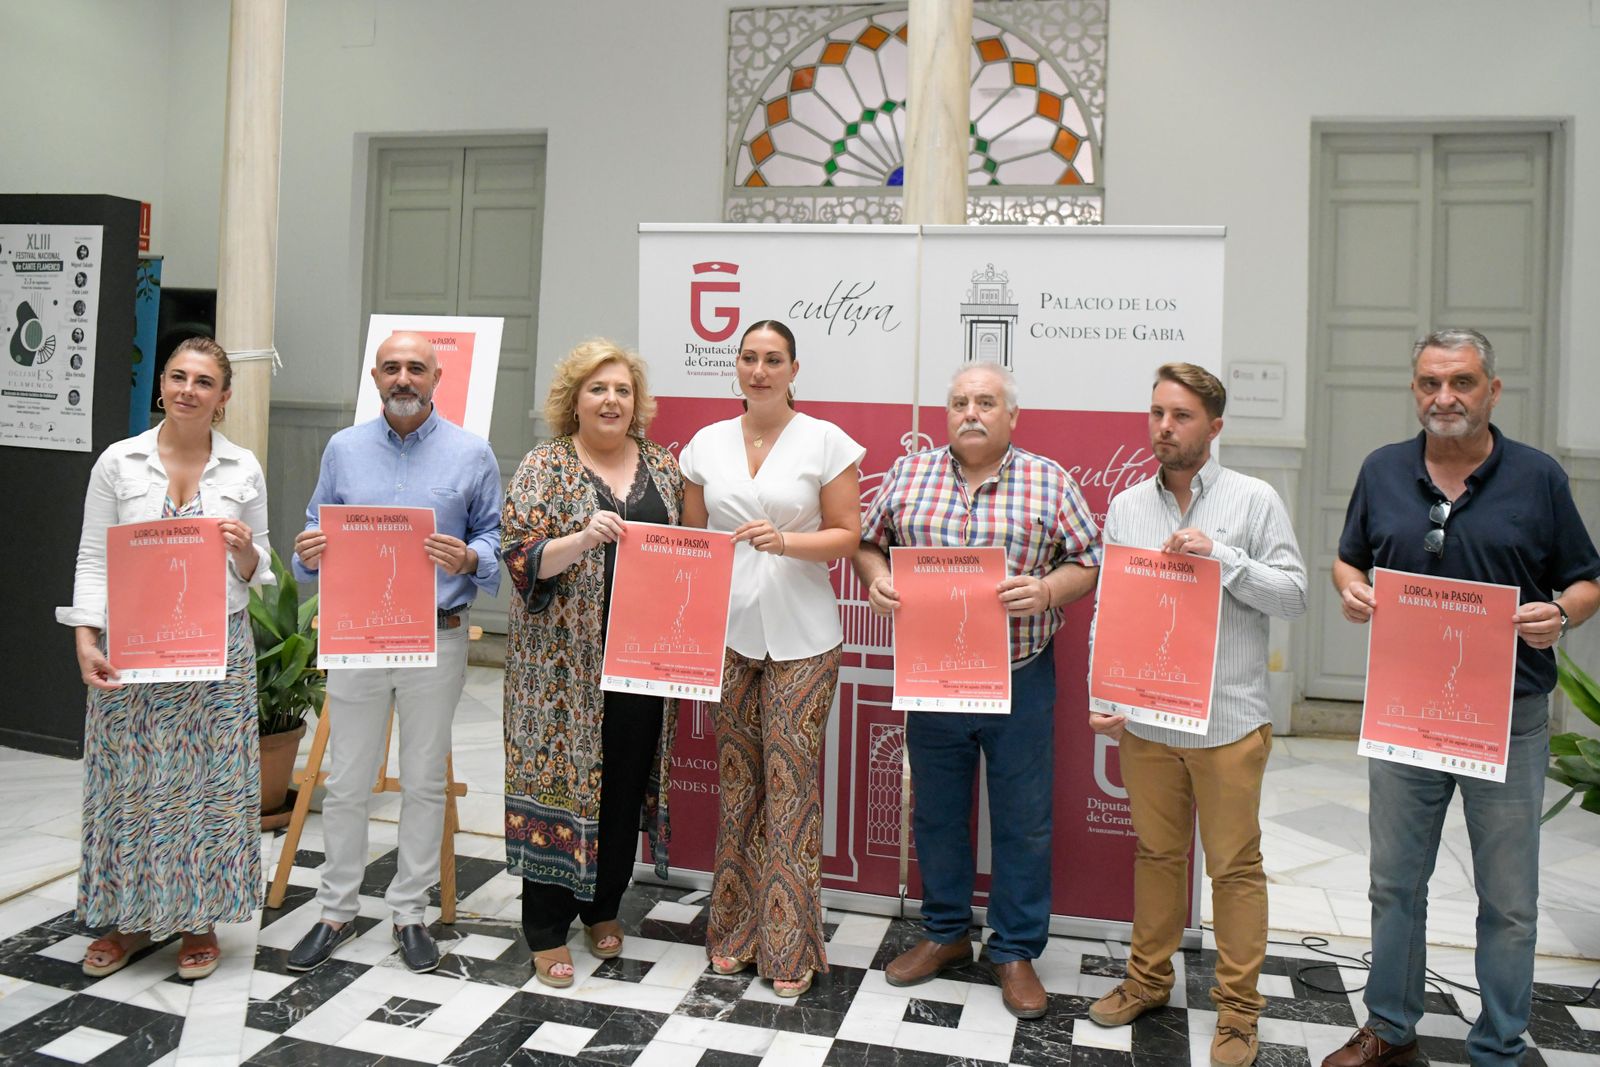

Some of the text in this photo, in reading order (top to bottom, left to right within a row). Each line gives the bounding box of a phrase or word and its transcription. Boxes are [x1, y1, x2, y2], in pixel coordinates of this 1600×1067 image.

[27, 233, 50, 250] XLIII
[38, 252, 60, 260] NACIONAL
[22, 262, 36, 270] CANTE
[37, 262, 60, 270] FLAMENCO
[788, 280, 902, 336] cultura
[1040, 292, 1177, 311] PALACIO DE LOS
[1030, 322, 1185, 341] CONDES DE GABIA
[685, 344, 740, 356] Diputació
[685, 356, 736, 368] de Grana
[1068, 445, 1156, 504] cultu
[346, 514, 369, 523] LORCA
[384, 514, 408, 523] PASIÓN
[134, 528, 158, 538] LORCA
[174, 526, 200, 535] PASIÓN
[130, 538, 164, 546] MARINA
[646, 534, 669, 544] LORCA
[677, 538, 682, 546] la
[684, 538, 709, 549] PASIÓN
[641, 544, 712, 559] MARINA HEREDIA
[917, 556, 940, 565] LORCA
[955, 555, 979, 565] PASIÓN
[1130, 556, 1152, 568] LORCA
[1160, 561, 1165, 569] la
[1168, 561, 1194, 574] PASIÓN
[1124, 566, 1198, 583] MARINA HEREDIA
[1404, 585, 1432, 598] LORCA
[1442, 590, 1449, 599] la
[1451, 590, 1483, 604] PASIÓN
[1398, 596, 1487, 616] MARINA HEREDIA
[671, 756, 717, 770] ALACIO
[711, 784, 720, 794] D
[1087, 798, 1132, 812] Diputac
[1087, 811, 1132, 825] de Gran
